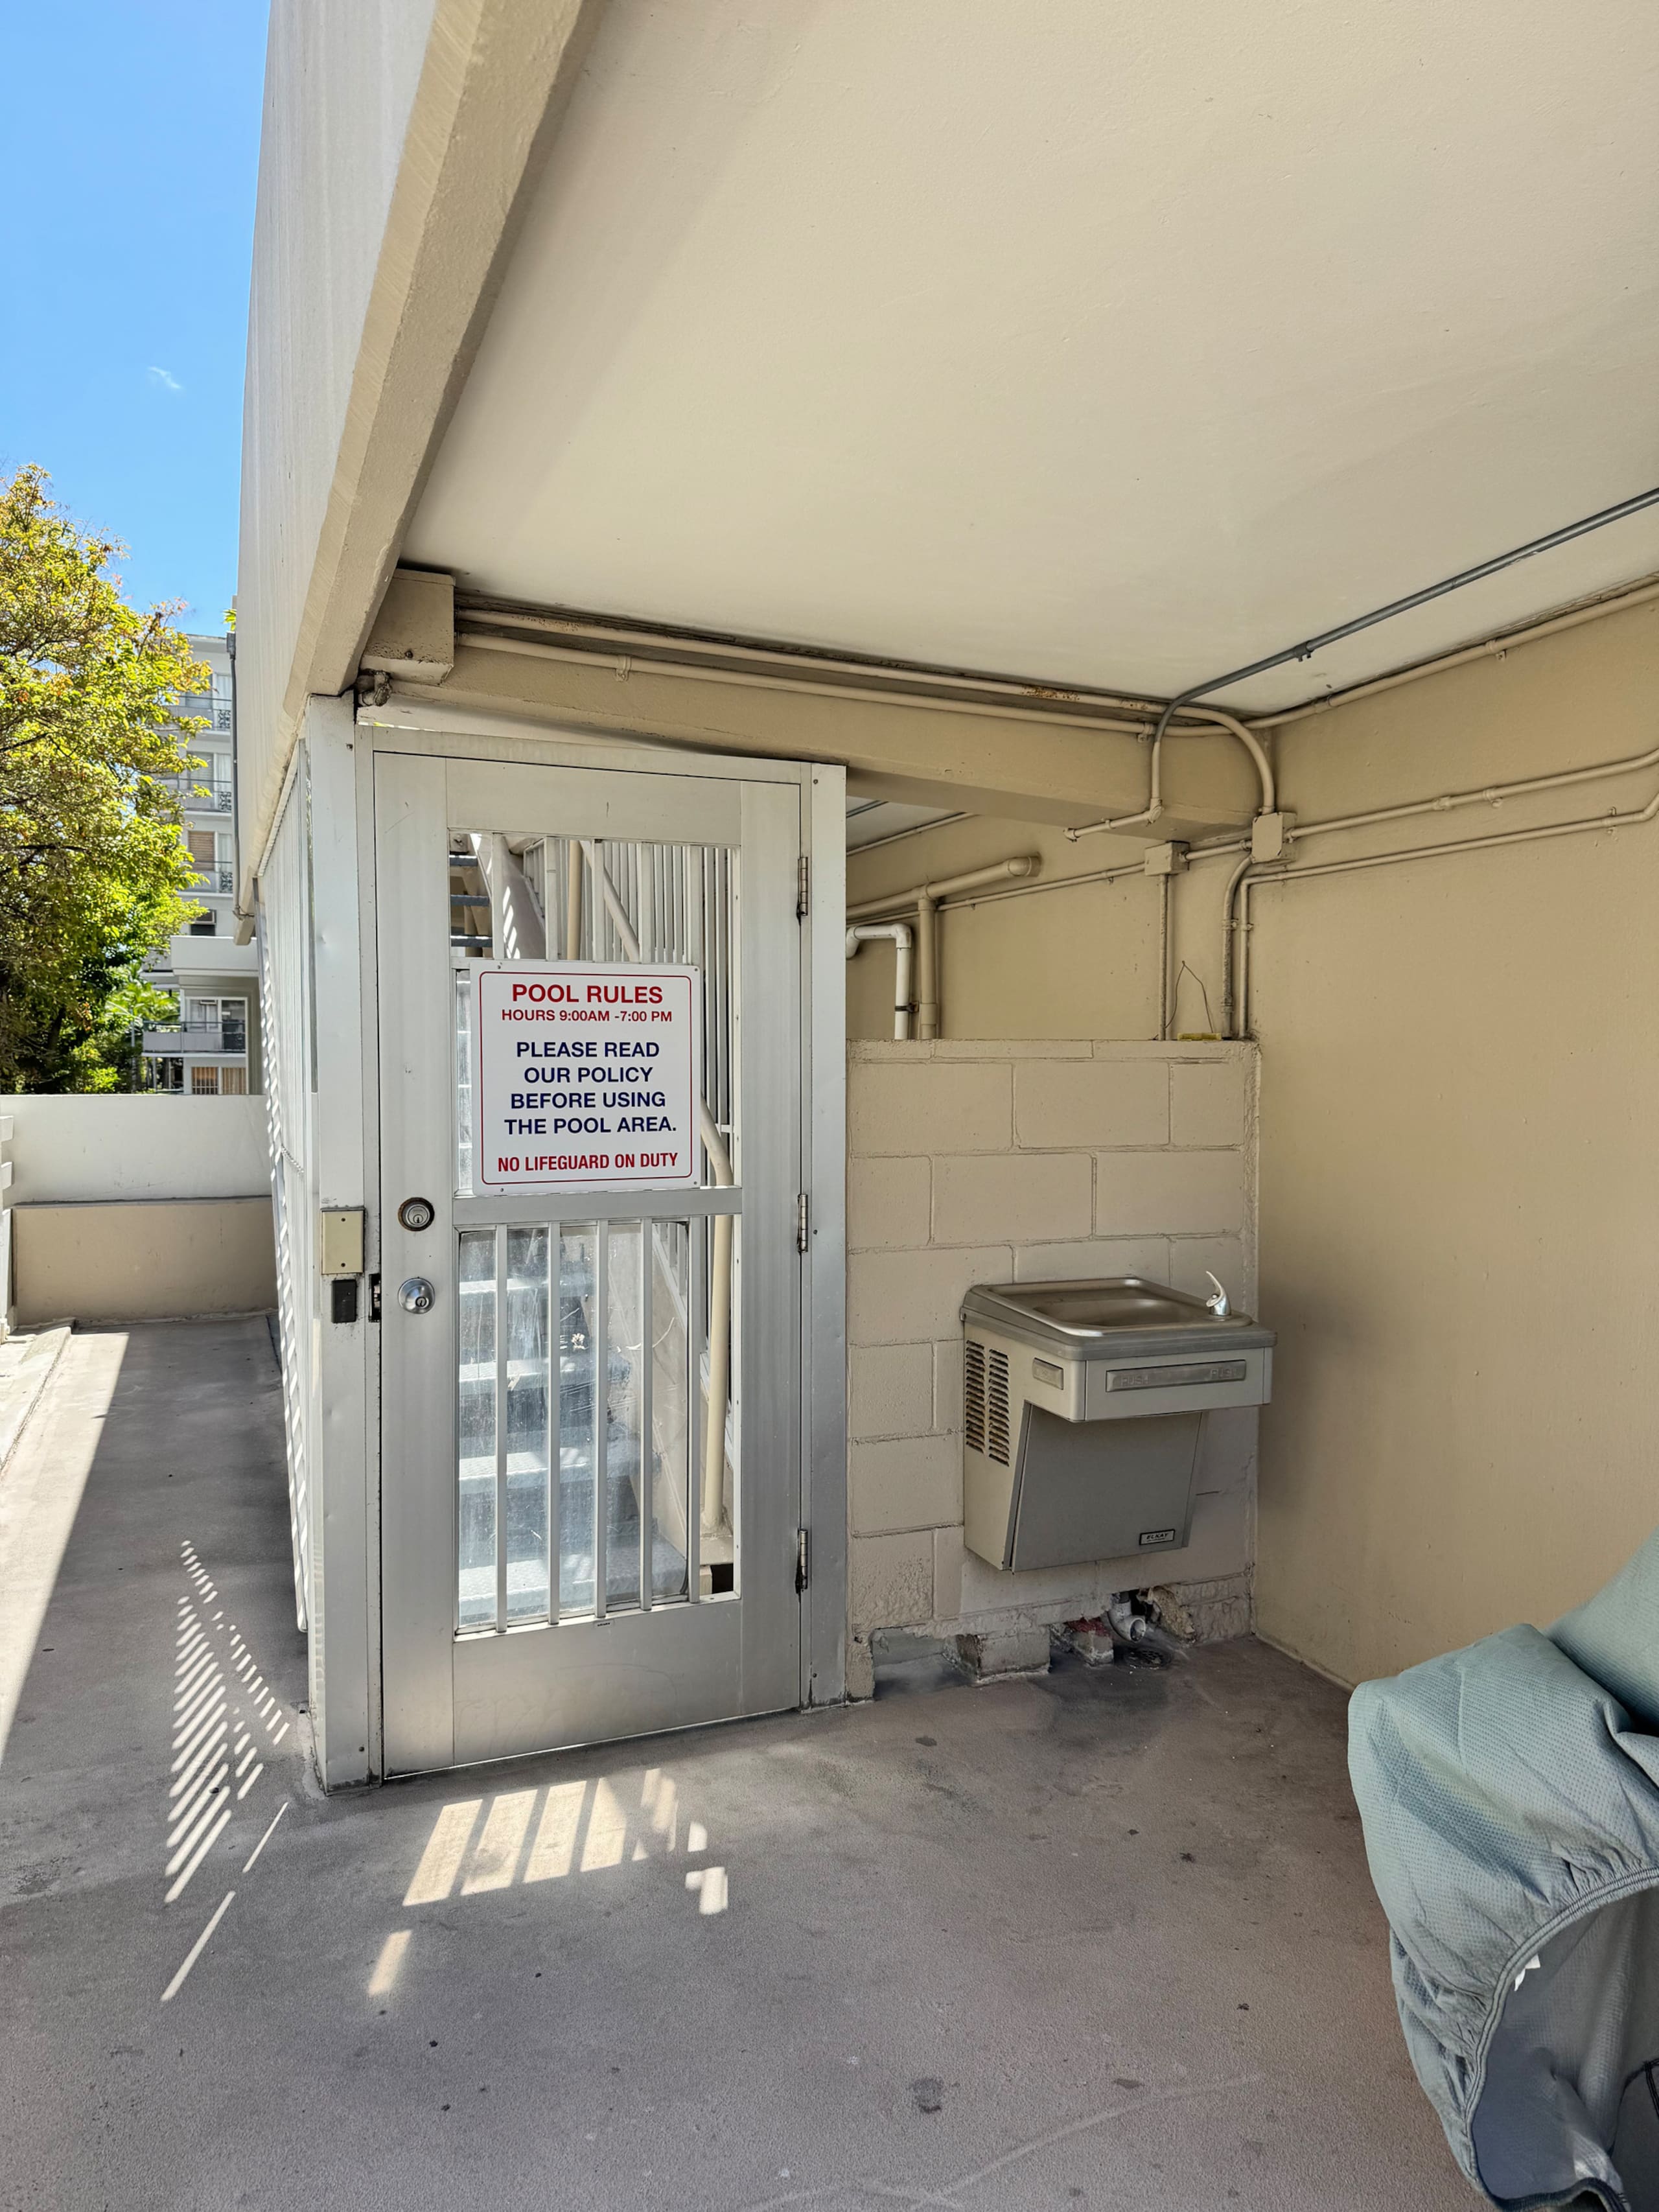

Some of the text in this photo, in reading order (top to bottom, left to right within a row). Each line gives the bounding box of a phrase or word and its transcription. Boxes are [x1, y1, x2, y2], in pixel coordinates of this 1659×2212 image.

[512, 983, 663, 1004] POOL RULES
[502, 1009, 672, 1022] HOURS 9:00AM -7:00 PM
[516, 1042, 660, 1057] PLEASE READ
[524, 1067, 653, 1083] OUR POLICY
[511, 1091, 666, 1109] BEFORE USING
[504, 1117, 677, 1135] THE POOL AREA.
[498, 1152, 679, 1172] NO LIFEGUARD ON DUTY
